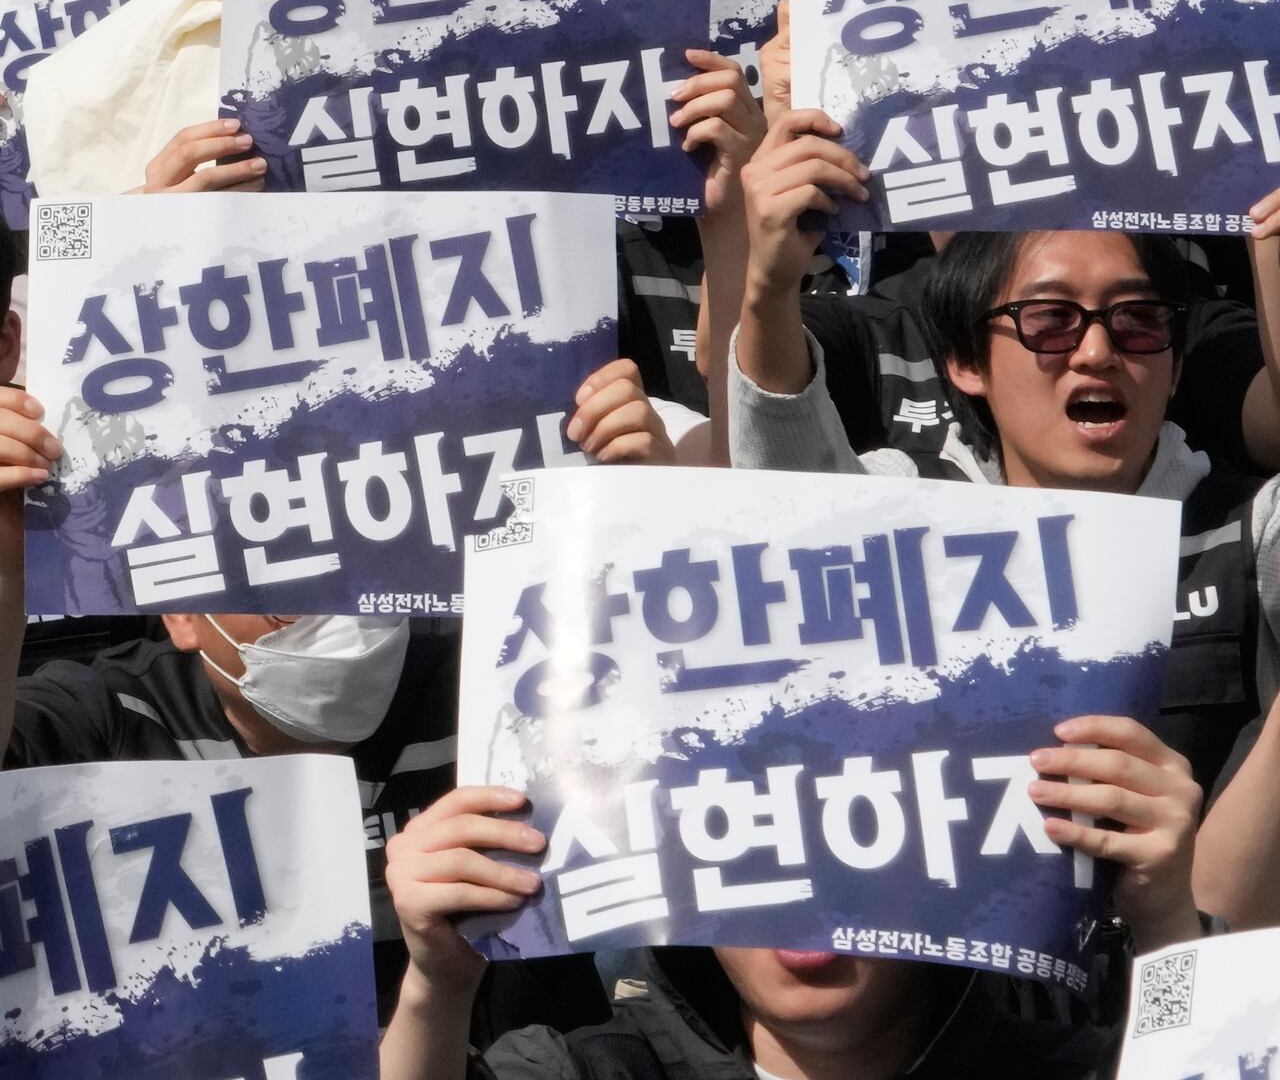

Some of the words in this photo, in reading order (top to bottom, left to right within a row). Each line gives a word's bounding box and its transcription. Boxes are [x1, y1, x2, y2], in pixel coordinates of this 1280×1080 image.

[290, 49, 687, 193] 실현하자
[867, 58, 1280, 225] 실현하자
[615, 197, 700, 214] 공동투쟁본부
[1092, 211, 1221, 231] 삼성전자노동조합
[69, 214, 545, 411] 상한폐지
[357, 593, 465, 614] 삼성전자노동
[496, 514, 1079, 717] 상한폐지
[831, 926, 1014, 969] 삼성전자노동조합
